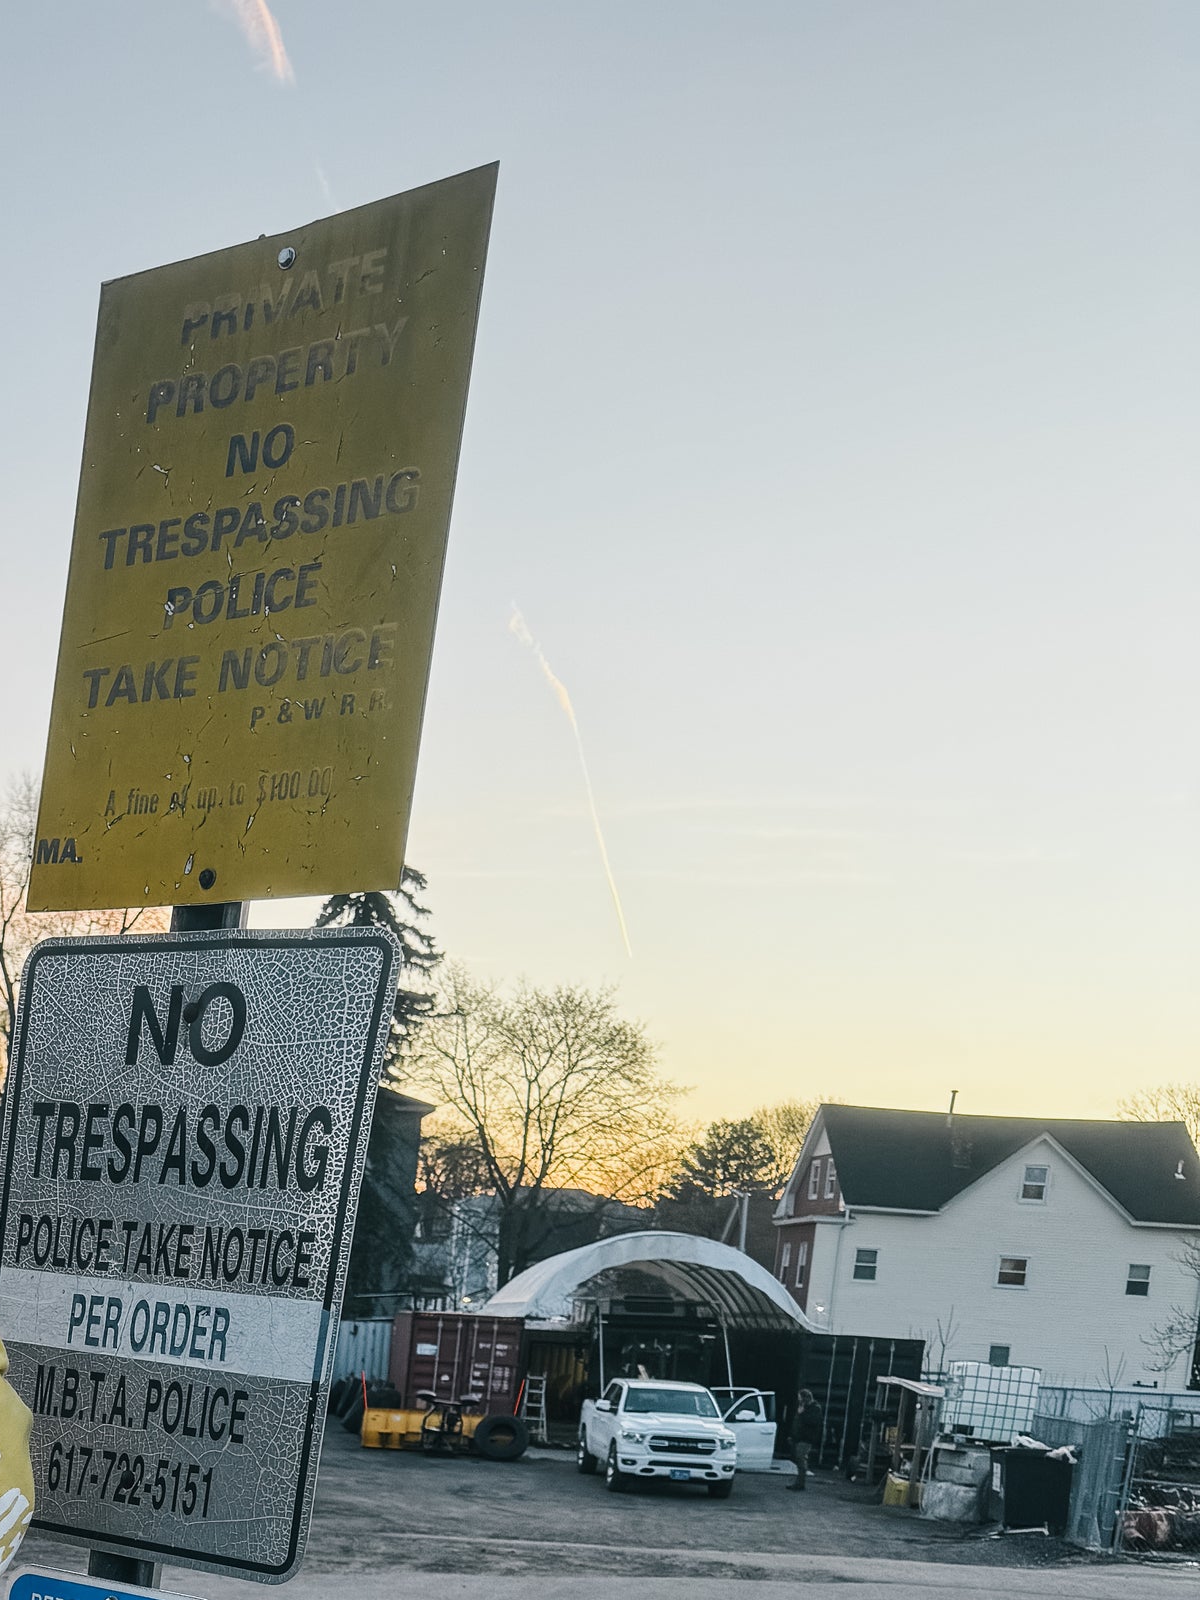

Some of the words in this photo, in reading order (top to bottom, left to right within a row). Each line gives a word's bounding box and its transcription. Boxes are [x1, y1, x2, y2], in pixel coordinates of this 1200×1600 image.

[181, 248, 388, 345] PRIVATE
[146, 316, 409, 424] PROPERTY
[225, 422, 296, 478] NO
[99, 466, 421, 570] TRESPASSING
[163, 562, 323, 630] POLICE
[83, 655, 200, 709] TAKE
[218, 622, 399, 693] NOTICE
[276, 700, 293, 724] &
[104, 789, 116, 817] A
[127, 787, 160, 815] fine
[229, 780, 246, 807] to
[258, 766, 334, 803] $100.00
[36, 837, 83, 865] MA.
[125, 981, 247, 1067] NO
[32, 1102, 333, 1192] TRESPASSING
[15, 1213, 113, 1272] POLICE
[122, 1220, 195, 1278] TAKE
[200, 1226, 317, 1288] NOTICE
[66, 1293, 124, 1349] PER
[129, 1299, 231, 1362] ORDER
[33, 1364, 133, 1429] M.B.T.A.
[143, 1378, 249, 1445] POLICE
[47, 1441, 214, 1518] 617-722-5151
